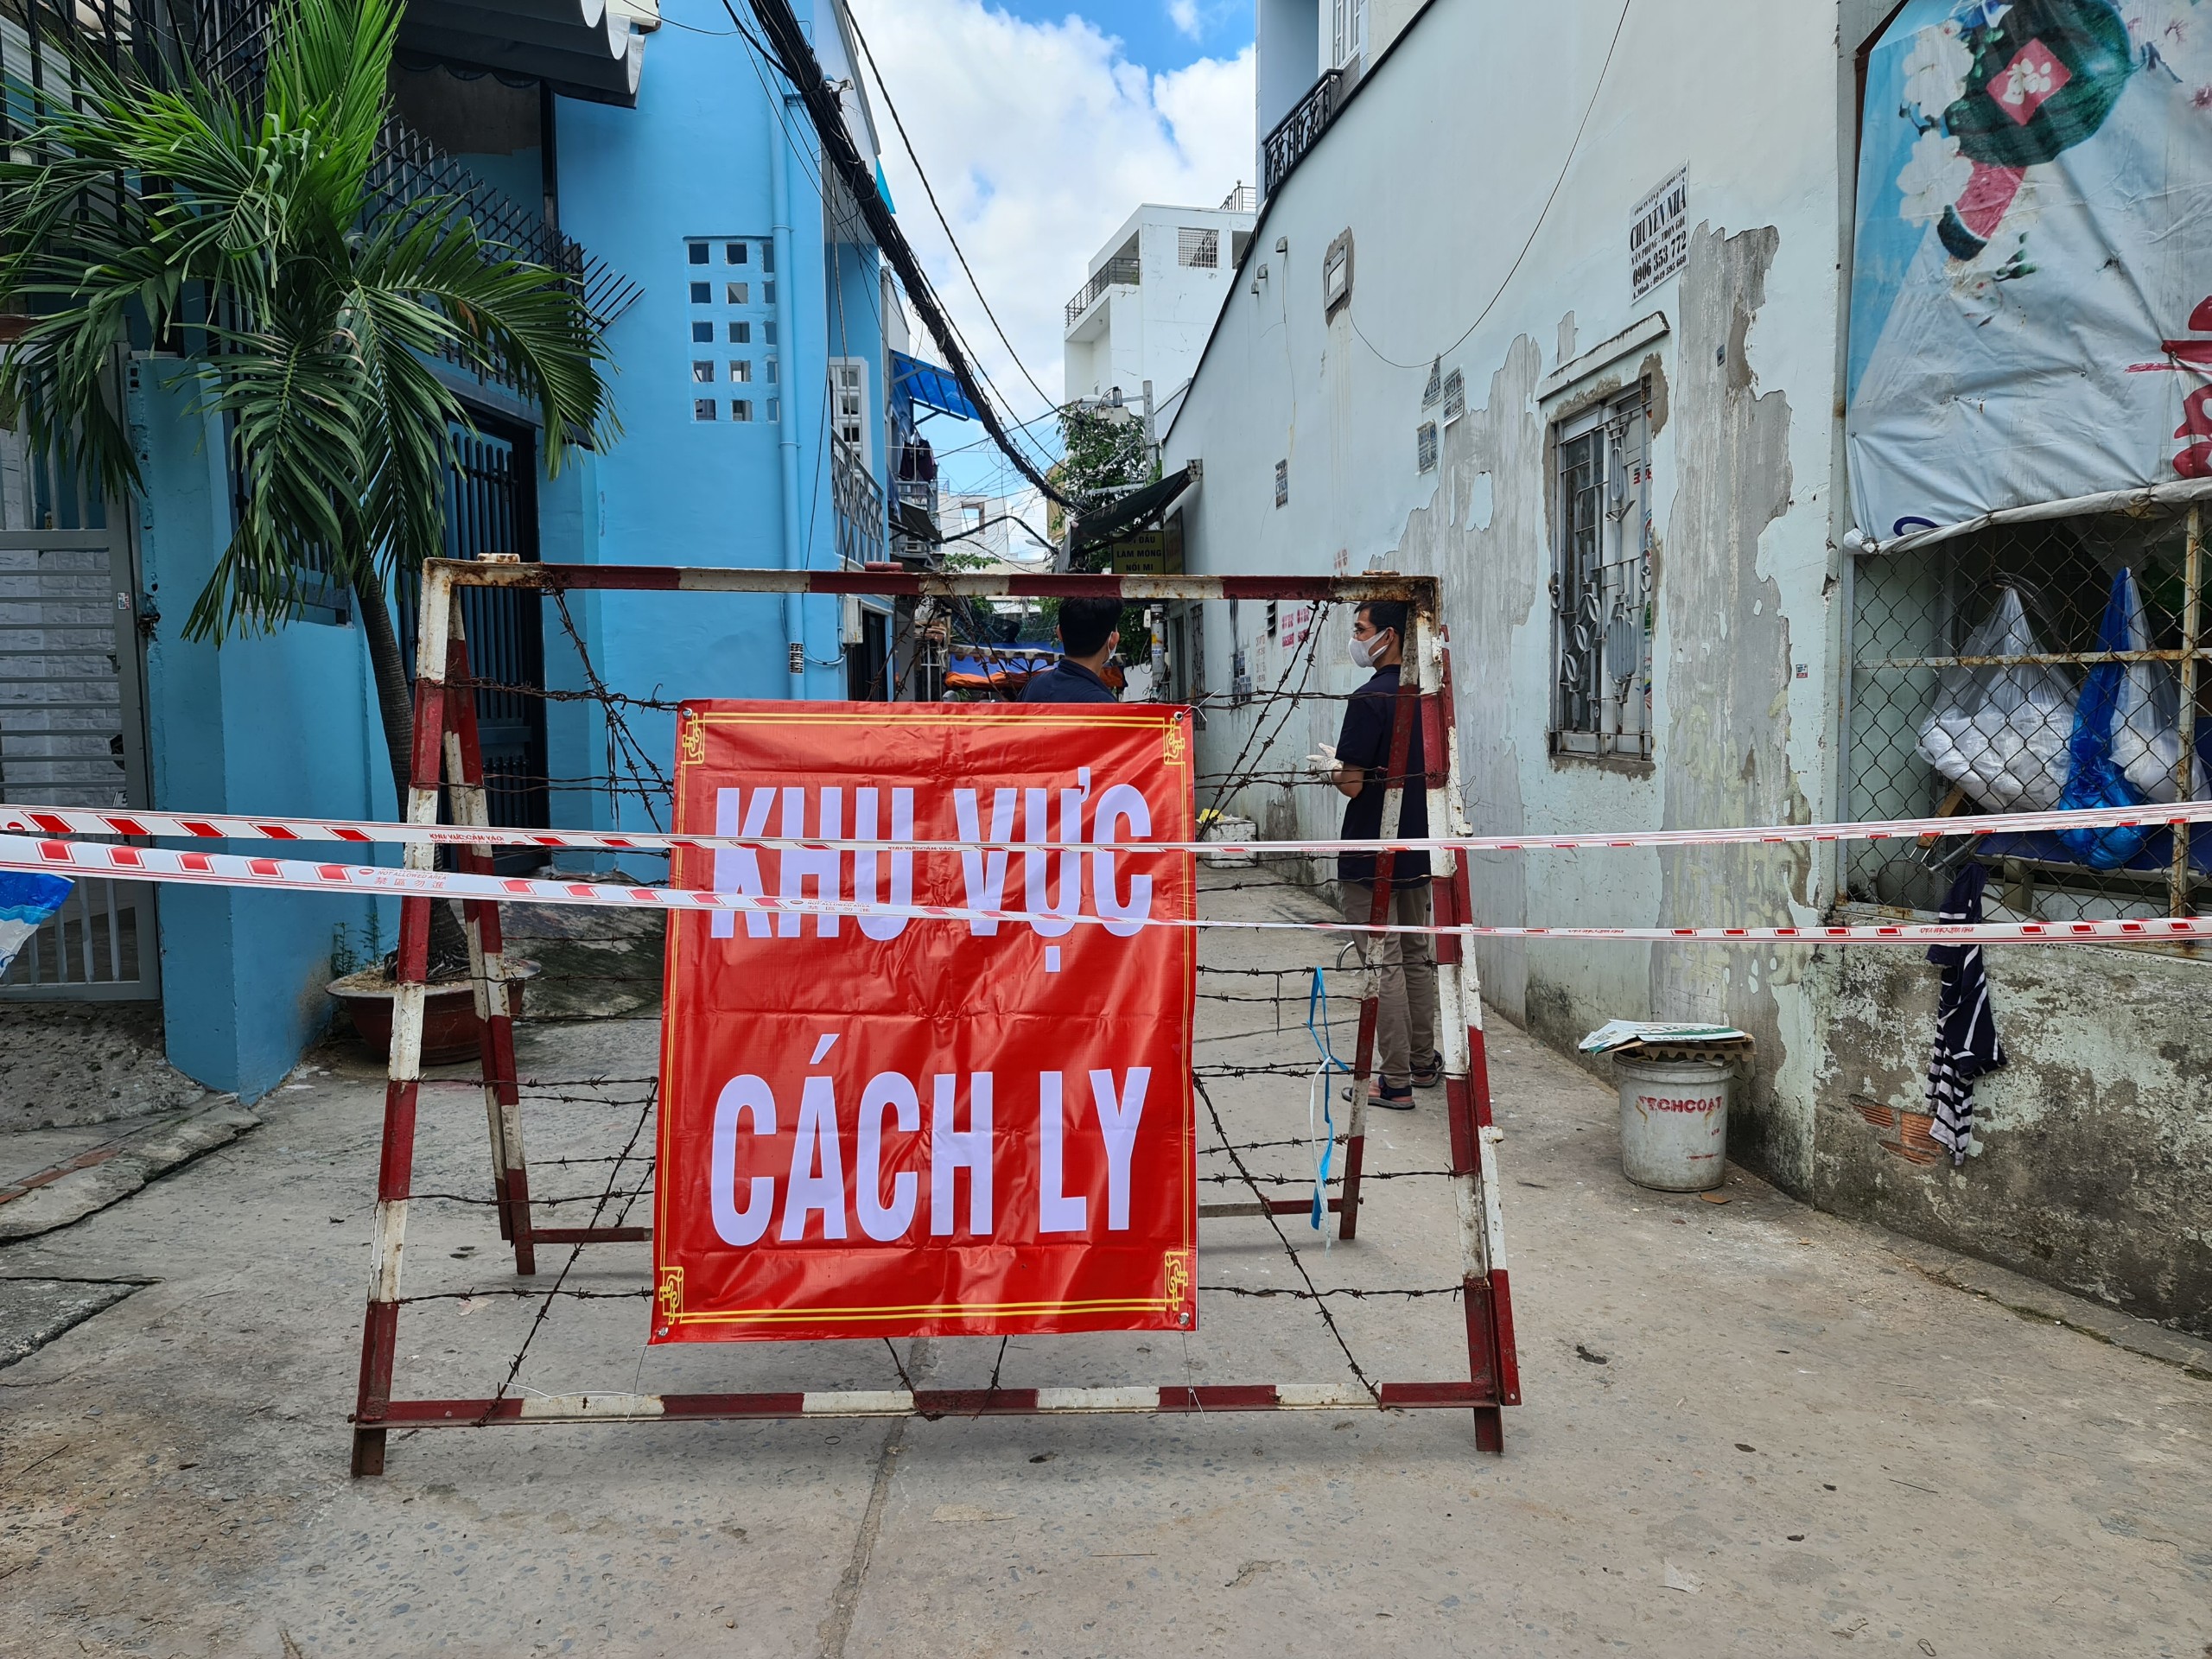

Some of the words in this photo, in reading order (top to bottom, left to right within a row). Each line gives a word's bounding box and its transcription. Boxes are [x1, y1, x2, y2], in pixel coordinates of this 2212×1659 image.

[1630, 192, 1666, 252] CHUYỂN
[1667, 176, 1687, 223] NHÀ
[1632, 257, 1651, 287] 0906
[1653, 245, 1669, 271] 353
[1671, 230, 1687, 258] 772
[710, 786, 914, 941] KHU
[954, 766, 1153, 973] VỰC
[711, 1033, 994, 1247] CÁCH
[1039, 1066, 1152, 1234] LY
